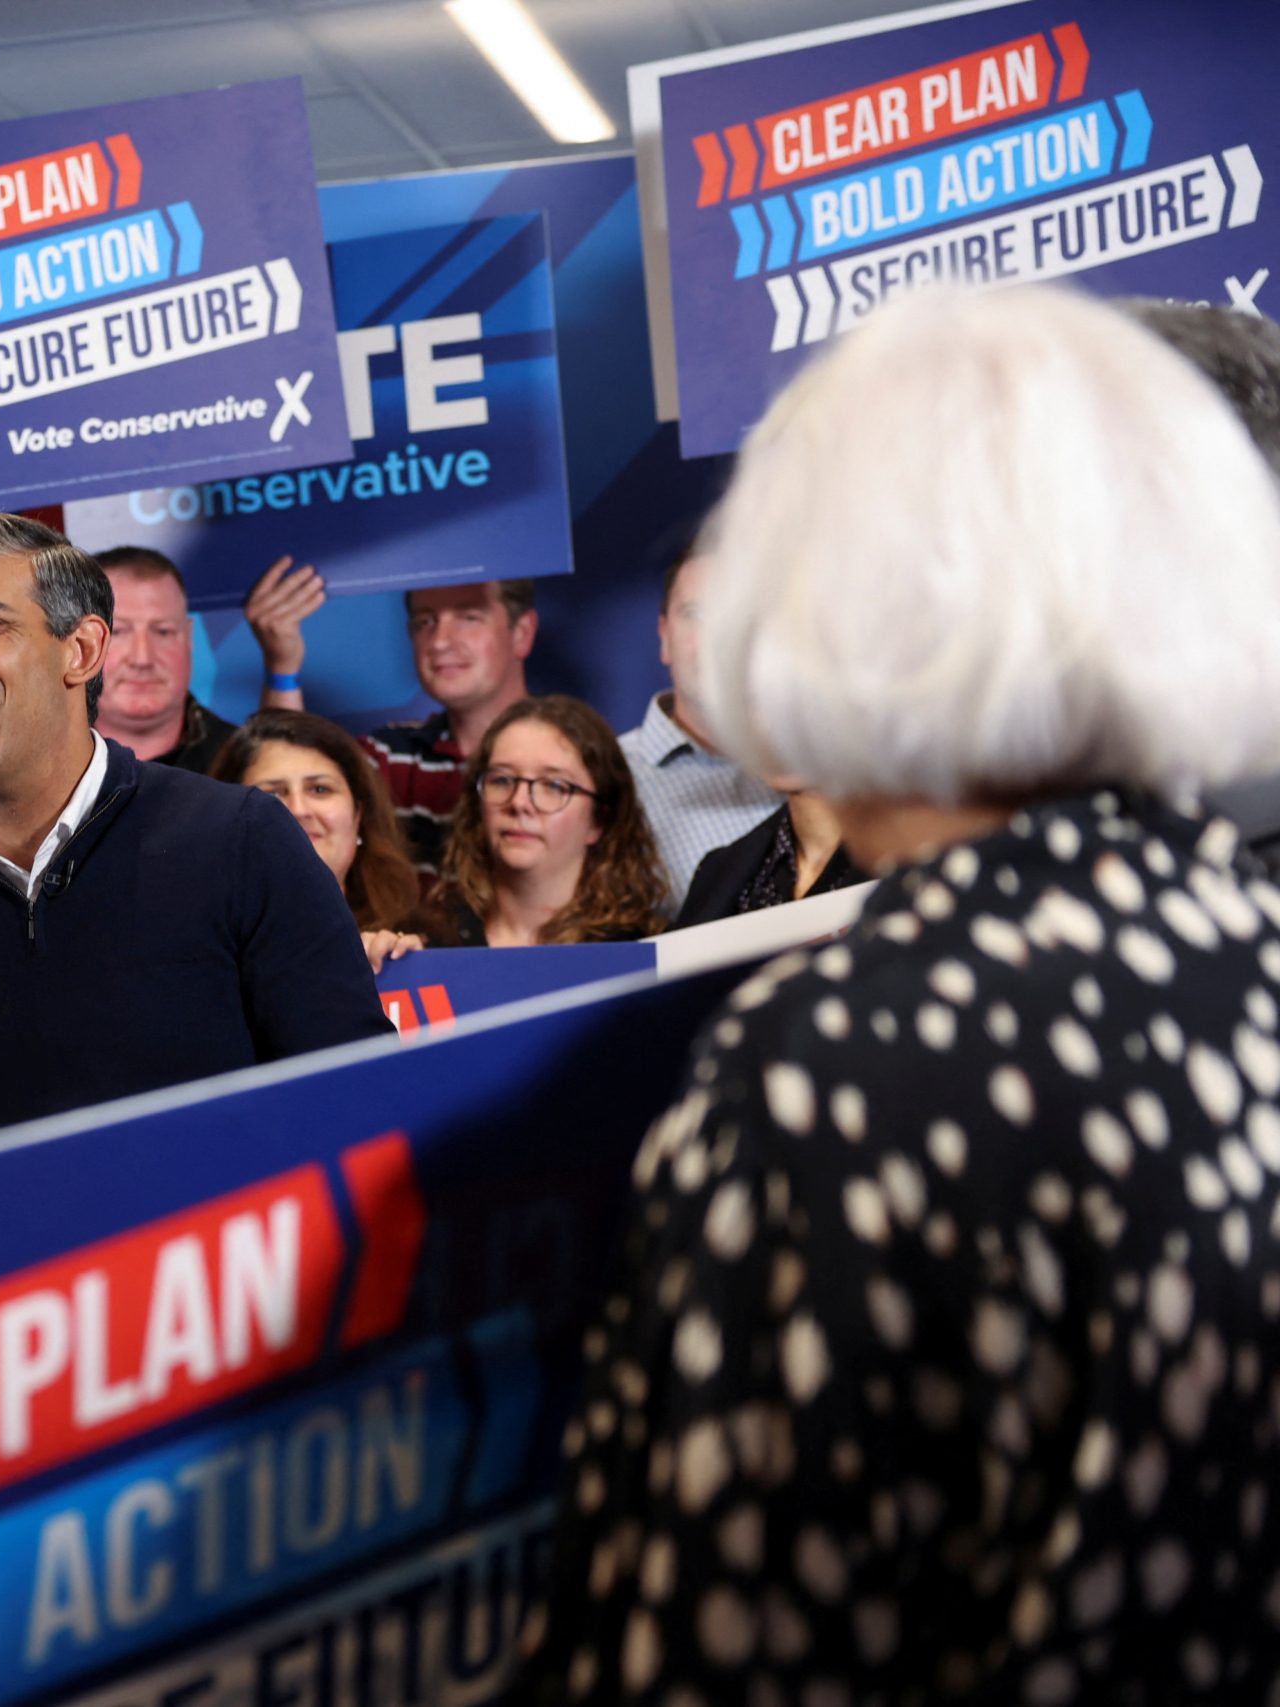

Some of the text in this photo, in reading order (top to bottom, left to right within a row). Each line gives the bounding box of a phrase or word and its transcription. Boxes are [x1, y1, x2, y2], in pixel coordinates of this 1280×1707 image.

[772, 46, 1037, 175] CLEAR PLAN
[812, 113, 1100, 246] BOLD ACTION
[1033, 170, 1209, 268] FUTURE
[15, 220, 160, 308] ACTION
[104, 279, 257, 365] FUTURE
[8, 426, 74, 455] Vote
[80, 396, 267, 443] Conservative
[337, 312, 489, 441] TE
[128, 443, 491, 525] Conservative
[26, 1370, 428, 1668] ACTION
